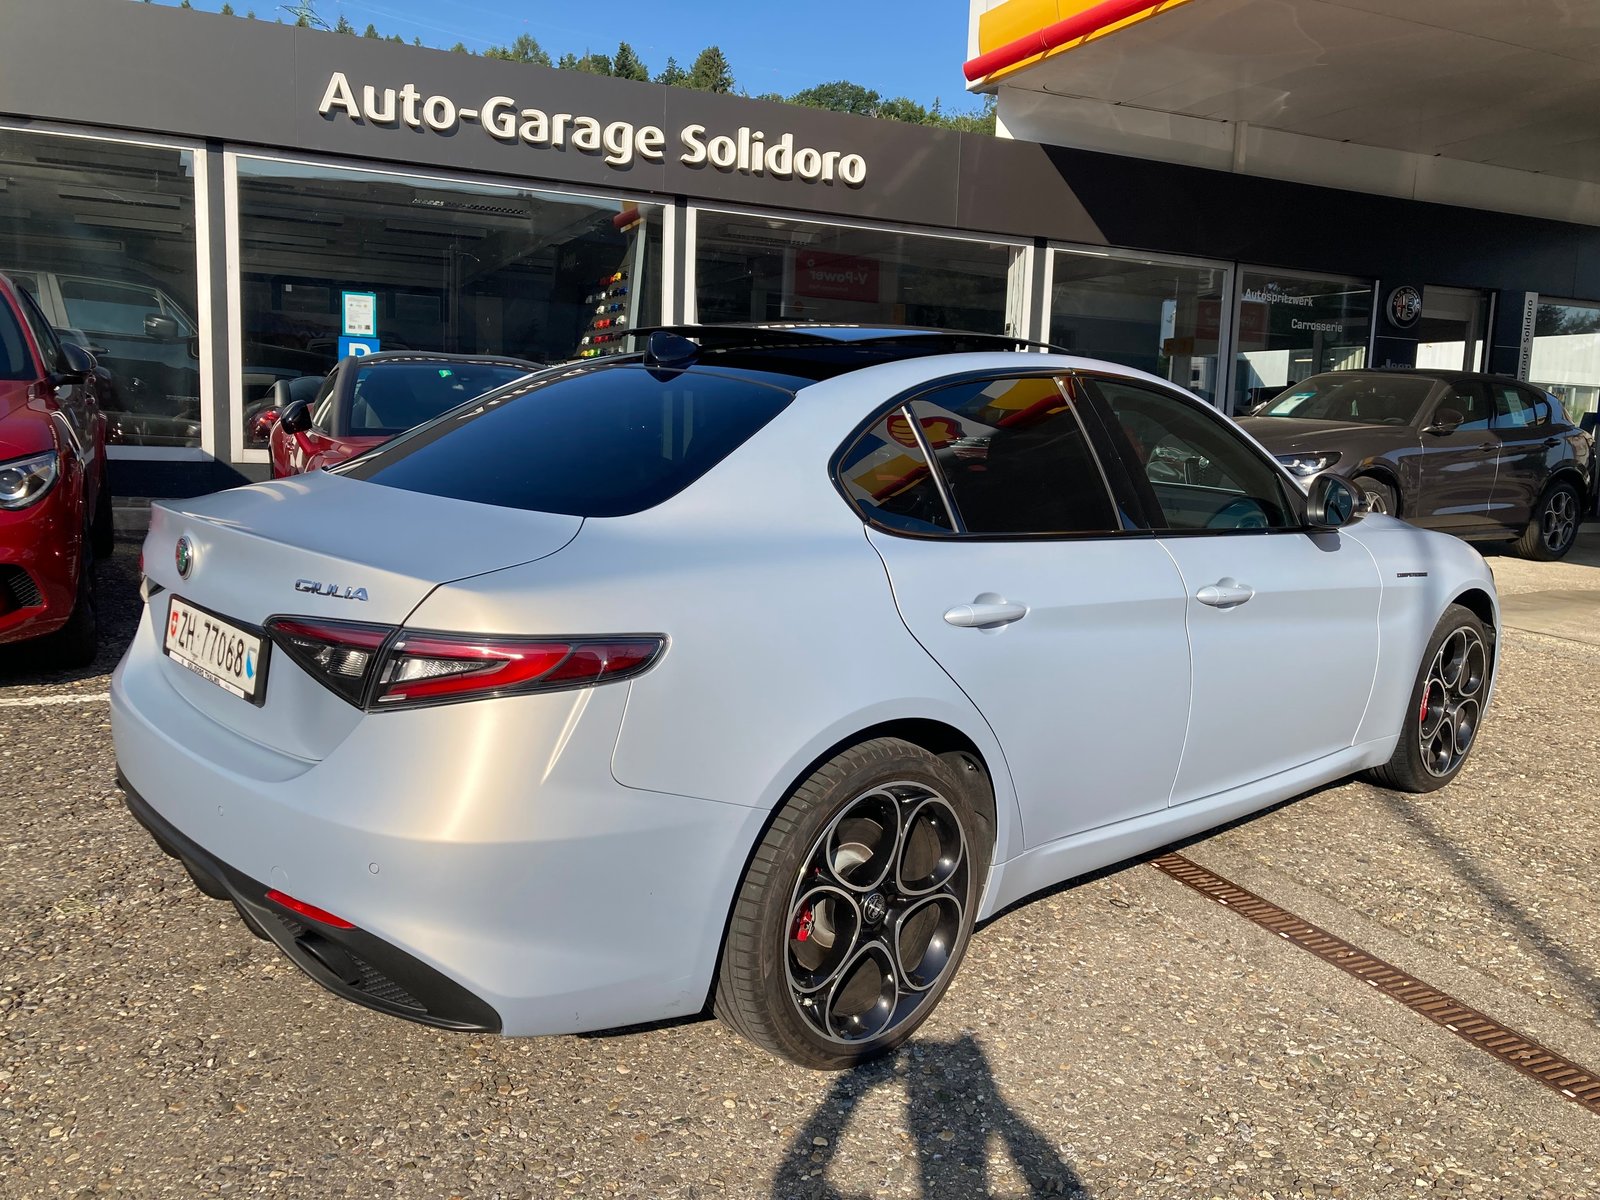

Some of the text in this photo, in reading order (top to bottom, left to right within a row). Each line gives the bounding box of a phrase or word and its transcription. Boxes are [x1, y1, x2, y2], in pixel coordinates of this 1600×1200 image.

[318, 71, 867, 184] Auto-Garage Solidoro
[1245, 288, 1314, 307] Autospritzwerk
[1291, 318, 1343, 333] Carrosserie
[1523, 299, 1534, 343] Solidoro
[294, 579, 368, 601] GIULIA
[178, 610, 244, 678] ZH 77068
